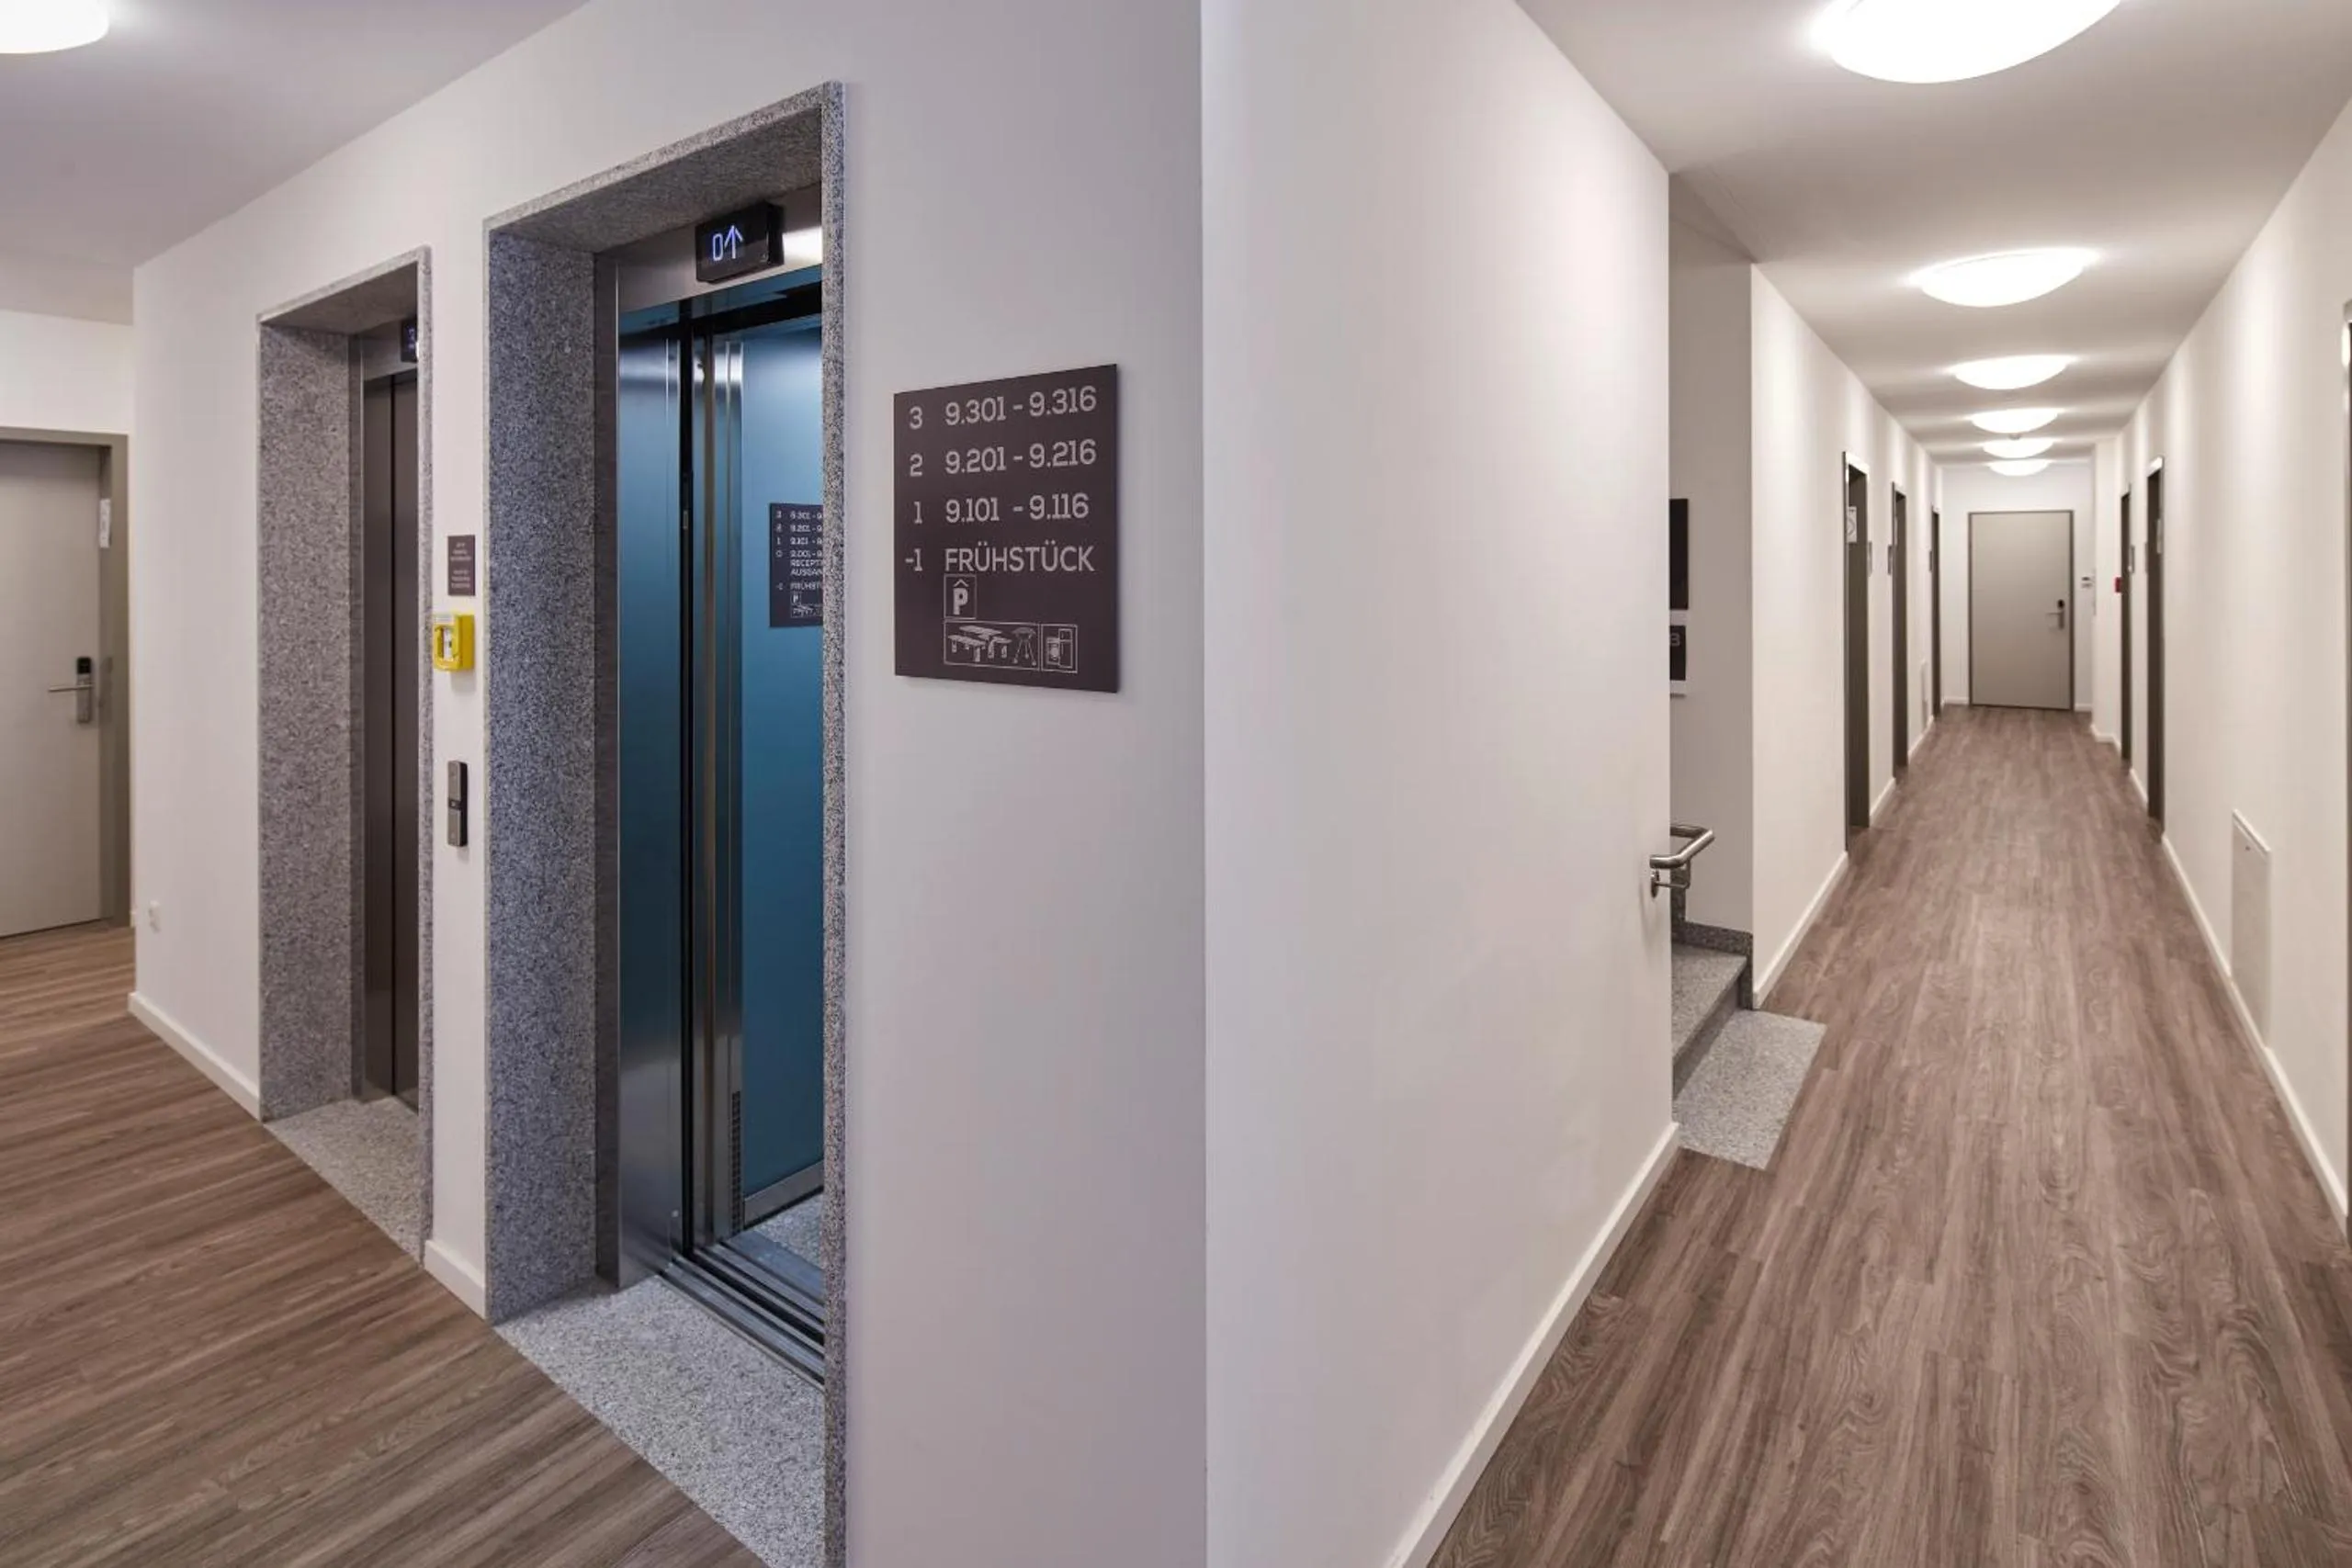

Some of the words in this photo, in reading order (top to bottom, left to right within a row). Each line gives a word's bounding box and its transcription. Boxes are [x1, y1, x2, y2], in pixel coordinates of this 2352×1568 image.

[909, 406, 923, 430] 3
[944, 395, 1007, 426] 9.301
[1028, 385, 1097, 417] 9.316
[909, 453, 923, 478] 2
[944, 446, 1007, 475] 9.201
[1028, 438, 1097, 468] 9.216
[913, 501, 923, 525] 1
[944, 497, 1001, 524] 9.101
[1028, 492, 1090, 521] 9.116
[905, 547, 923, 572] -1
[944, 539, 1095, 573] FRÜHSTÜCK
